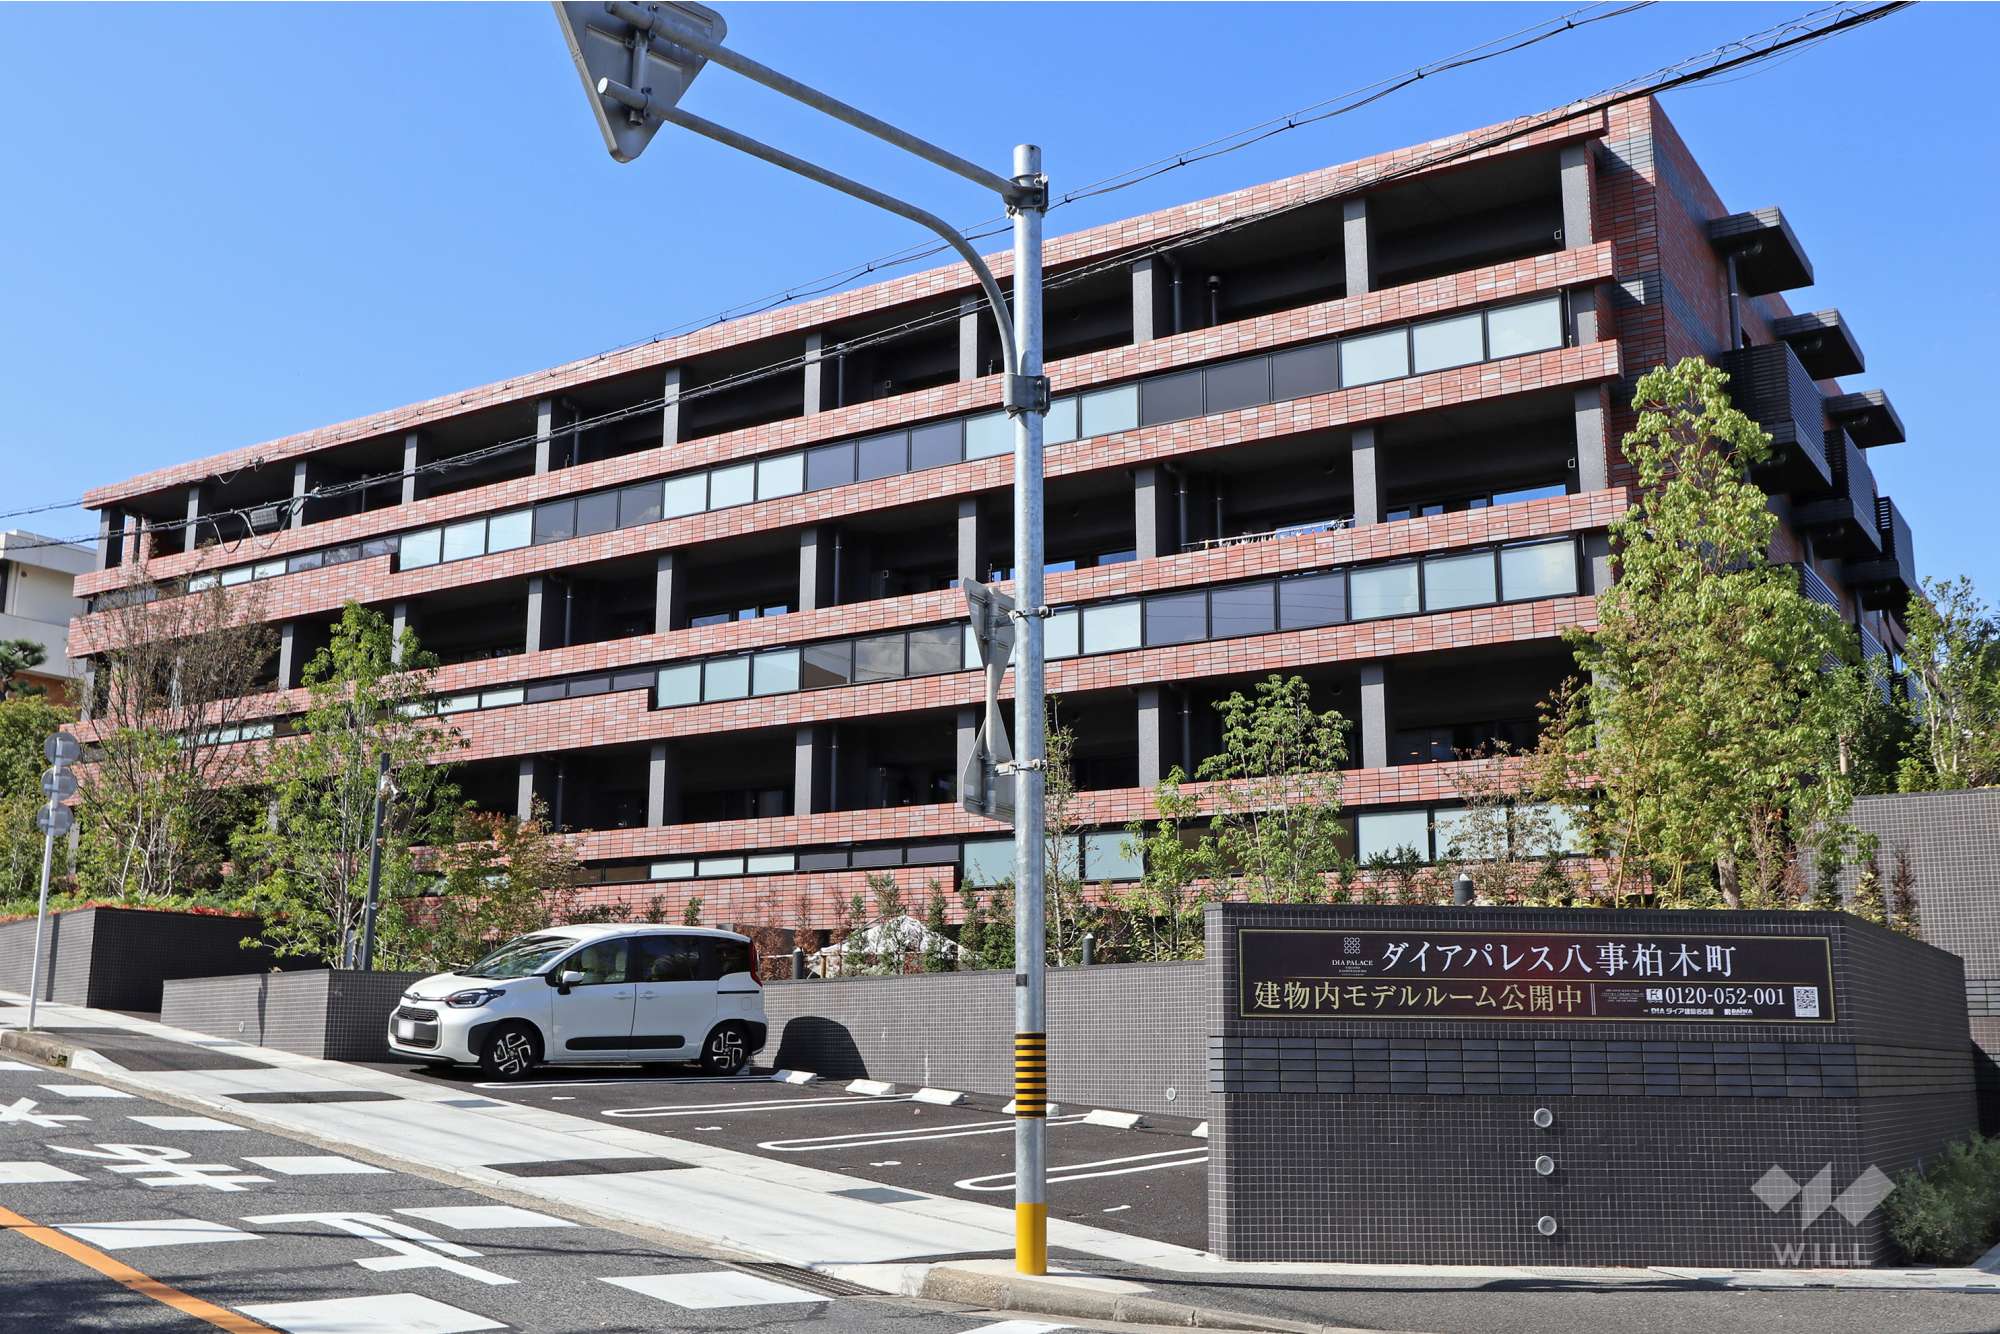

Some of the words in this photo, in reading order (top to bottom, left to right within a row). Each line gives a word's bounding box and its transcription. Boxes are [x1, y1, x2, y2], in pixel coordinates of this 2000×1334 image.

[1381, 940, 1737, 977] ダイアパレス八事柏木町
[1253, 980, 1583, 1013] 建物内モデルルーム公開中
[1665, 986, 1786, 1006] 0120-052-001
